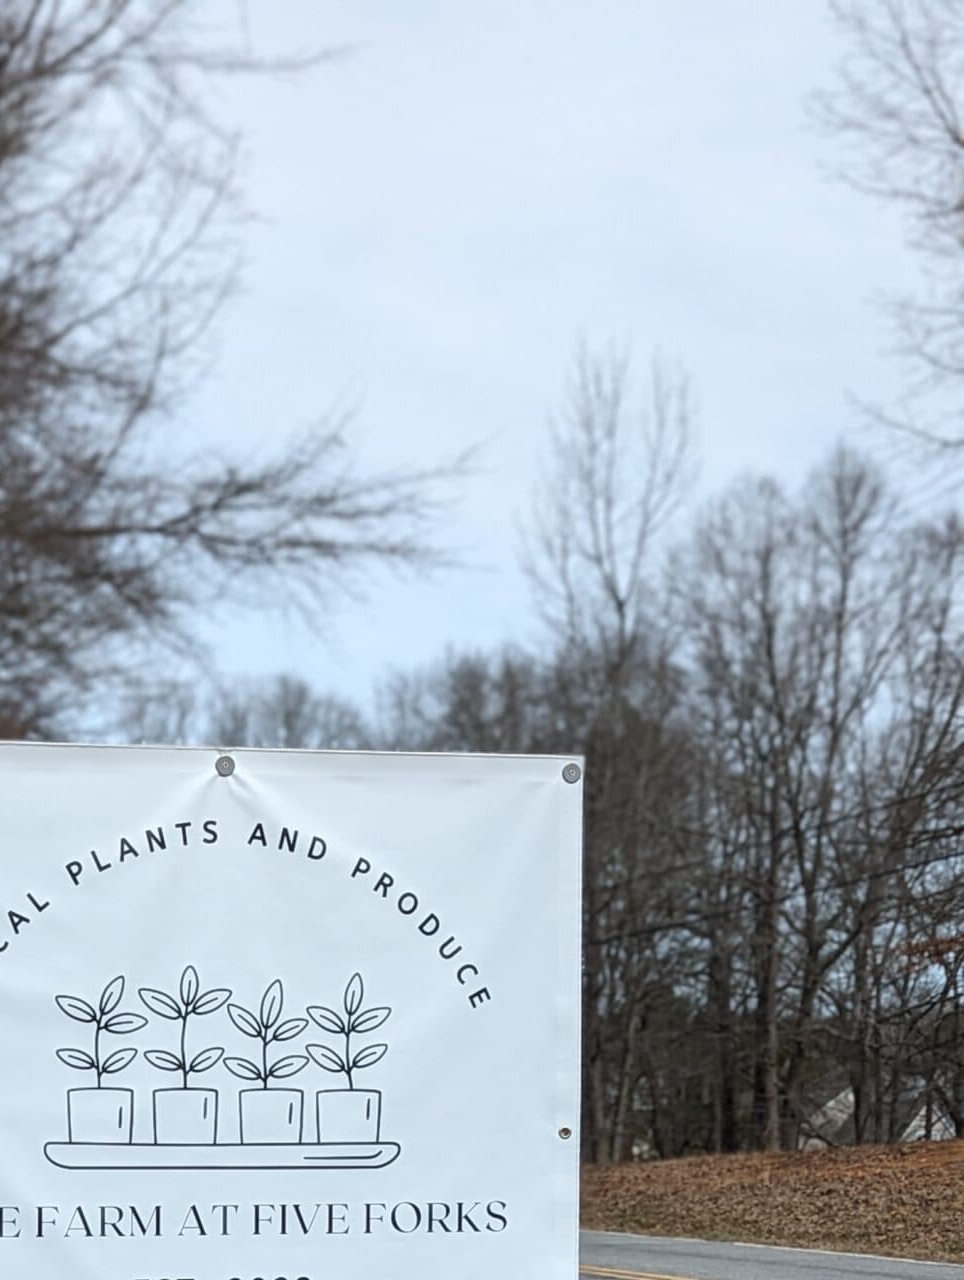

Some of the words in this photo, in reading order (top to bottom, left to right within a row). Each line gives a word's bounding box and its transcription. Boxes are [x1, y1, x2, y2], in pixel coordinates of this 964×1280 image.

[65, 820, 219, 887] PLANTS
[247, 822, 328, 861] AND
[350, 856, 492, 1009] PRODUCE
[35, 1205, 163, 1238] FARM
[177, 1204, 239, 1237] AT
[252, 1203, 349, 1236] FIVE
[363, 1200, 509, 1234] FORKS
